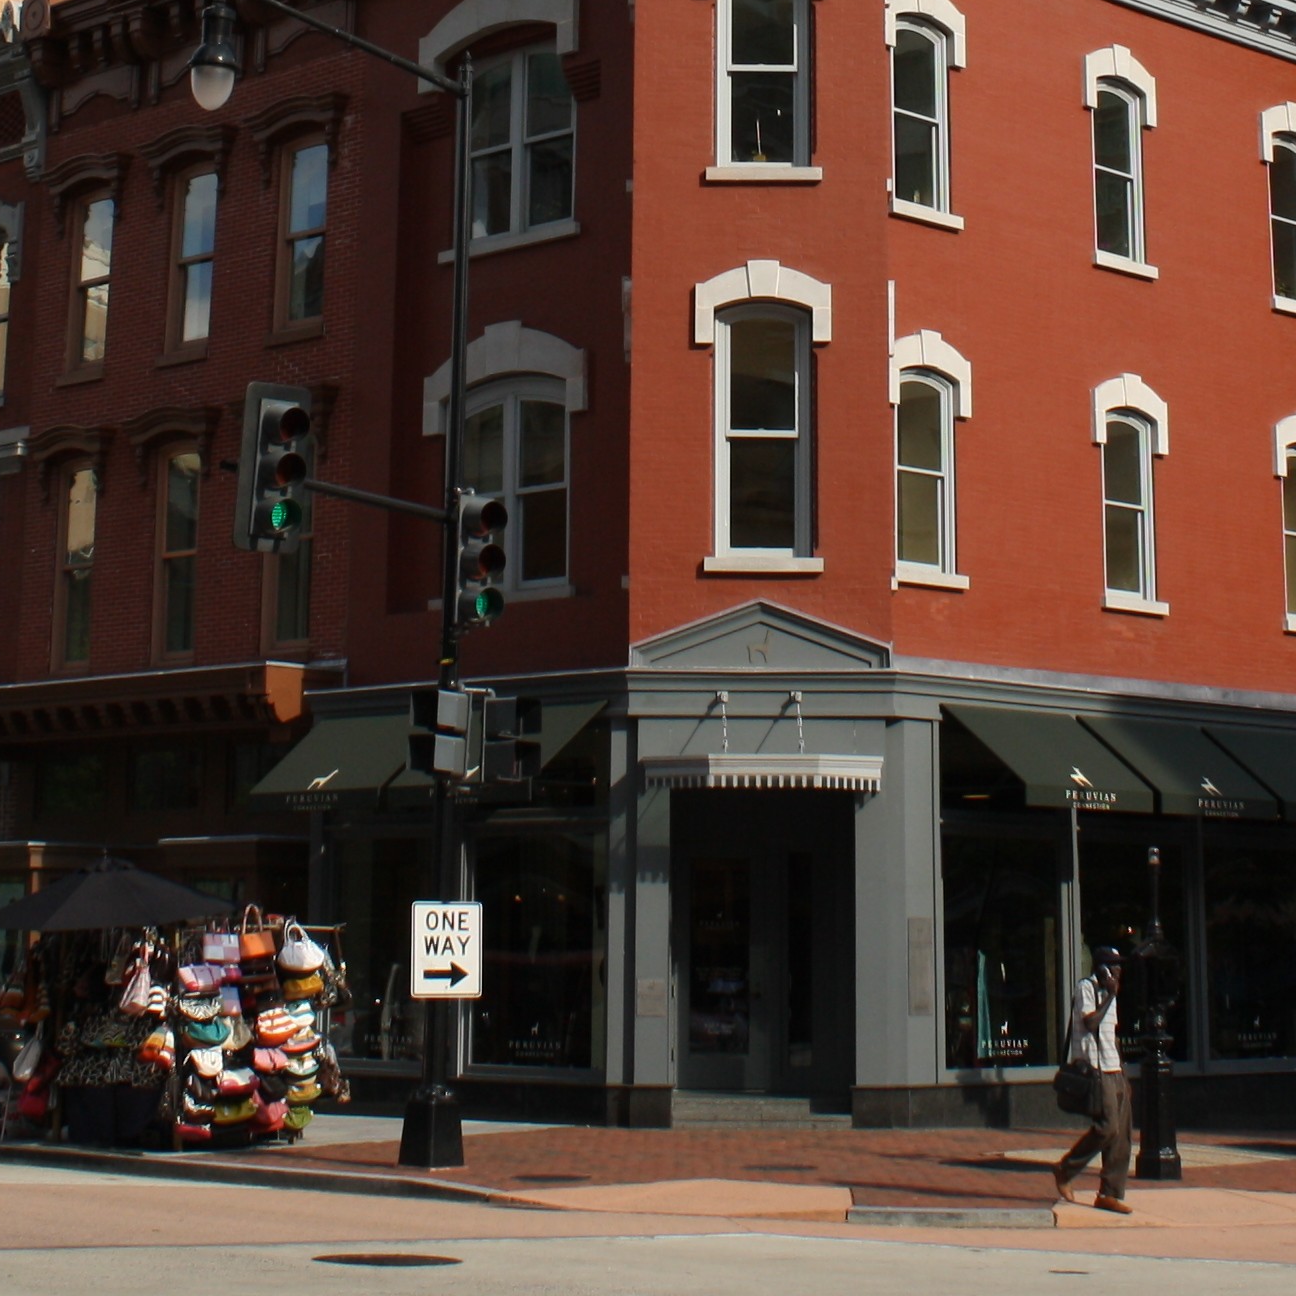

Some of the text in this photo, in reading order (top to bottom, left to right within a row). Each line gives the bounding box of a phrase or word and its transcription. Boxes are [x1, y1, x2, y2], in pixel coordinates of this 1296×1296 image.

[286, 793, 338, 804] PERUVIAN
[1066, 789, 1117, 802] PERUVIAN
[1198, 798, 1245, 810] PERUVIAN
[425, 910, 470, 932] ONE
[424, 935, 472, 956] WAY
[981, 1039, 1029, 1049] PERUVIAN
